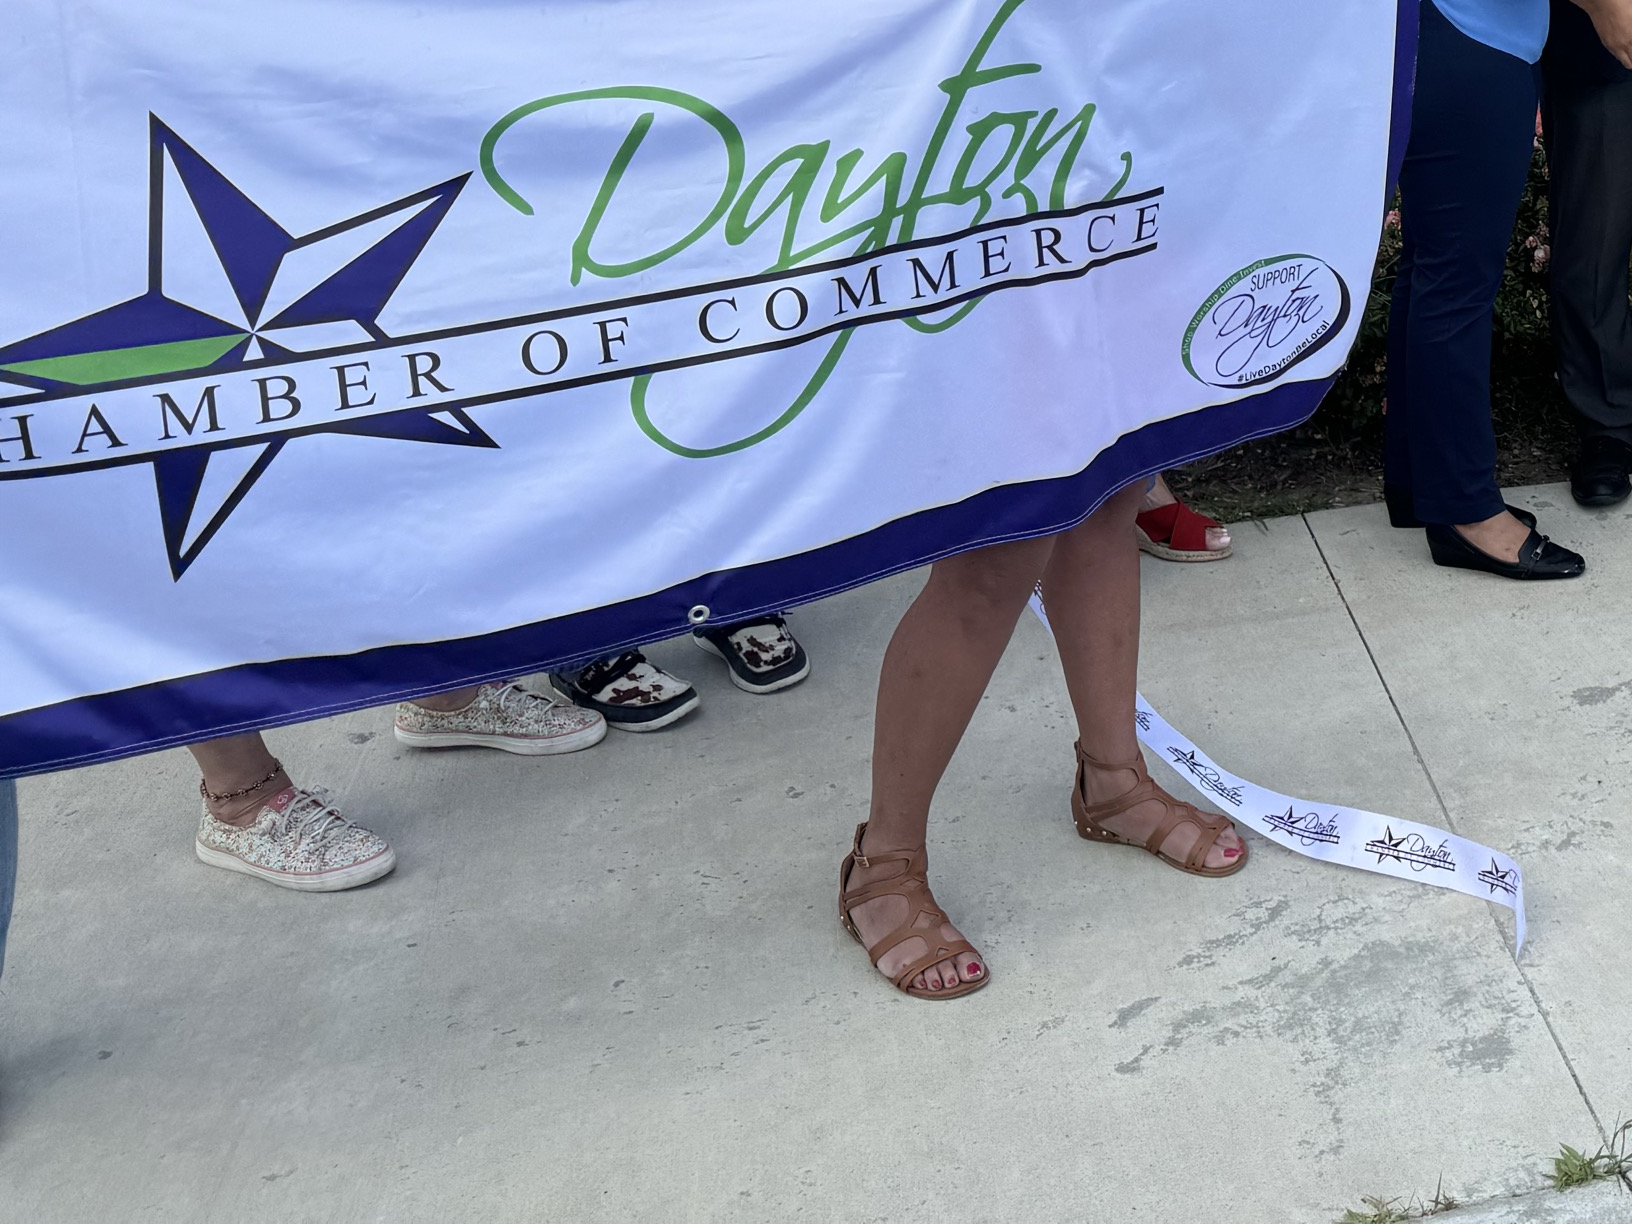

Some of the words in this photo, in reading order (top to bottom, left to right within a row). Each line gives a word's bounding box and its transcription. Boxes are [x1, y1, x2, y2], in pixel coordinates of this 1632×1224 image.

[521, 319, 631, 378] OF
[698, 202, 1161, 344] COMMERCE
[1182, 330, 1194, 355] Shop
[1192, 294, 1219, 327] Worship
[1219, 277, 1238, 294] Dine
[1239, 260, 1265, 278] Invest
[1212, 267, 1323, 378] Dayton
[1250, 263, 1303, 292] SUPPORT
[1237, 320, 1331, 383] #LiveDaytonBeLocal
